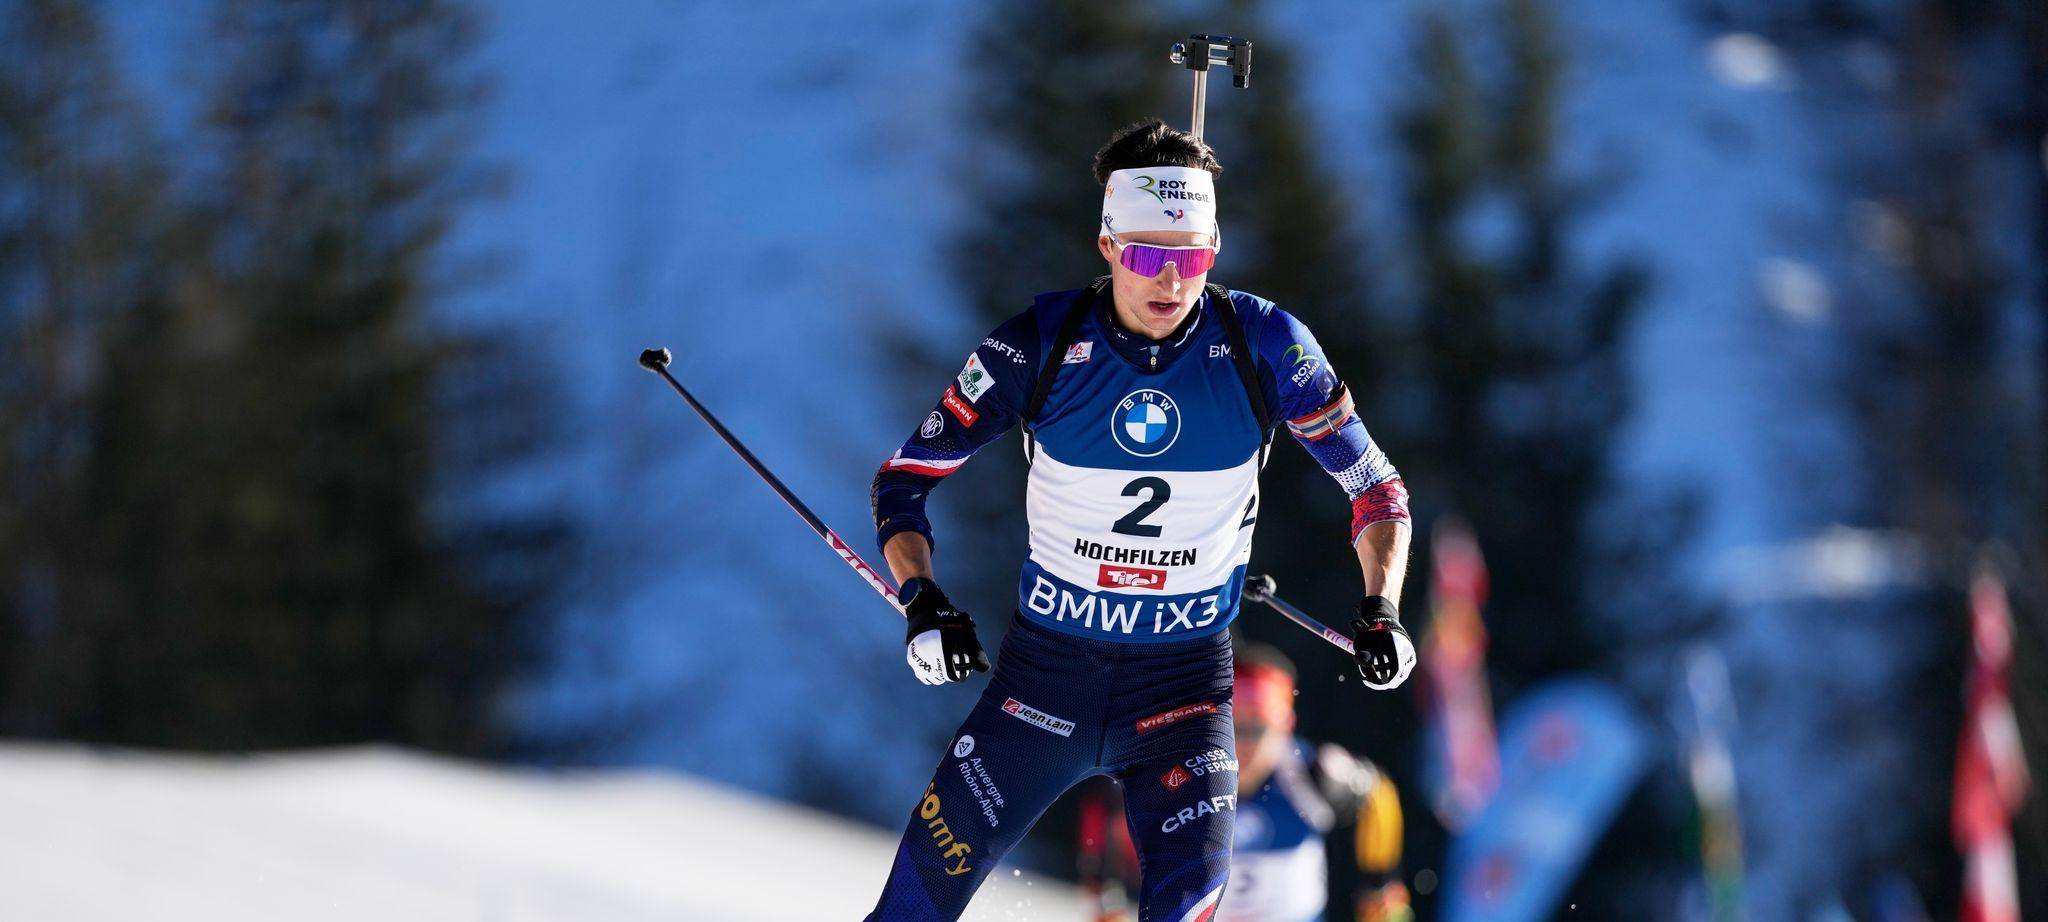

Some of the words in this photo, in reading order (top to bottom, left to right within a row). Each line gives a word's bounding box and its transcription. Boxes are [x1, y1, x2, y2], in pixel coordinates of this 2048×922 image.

[1159, 180, 1187, 189] ROY
[1159, 190, 1209, 203] ENERGIE
[1209, 343, 1236, 360] BM
[1291, 361, 1312, 383] ROY
[1122, 393, 1173, 411] BMW
[1111, 476, 1171, 538] 2
[1074, 538, 1197, 567] HOCHFILZEN
[1028, 575, 1143, 634] BMW
[1153, 595, 1219, 634] iX3
[1018, 707, 1046, 722] Jean
[1046, 718, 1073, 732] Lain
[1141, 704, 1211, 728] VIESMANN
[1185, 749, 1229, 768] CAISSE
[959, 761, 999, 828] Rhône-Alpes
[970, 757, 1004, 808] Auvergne-
[1161, 794, 1236, 833] CRAFT
[921, 782, 972, 876] somfy
